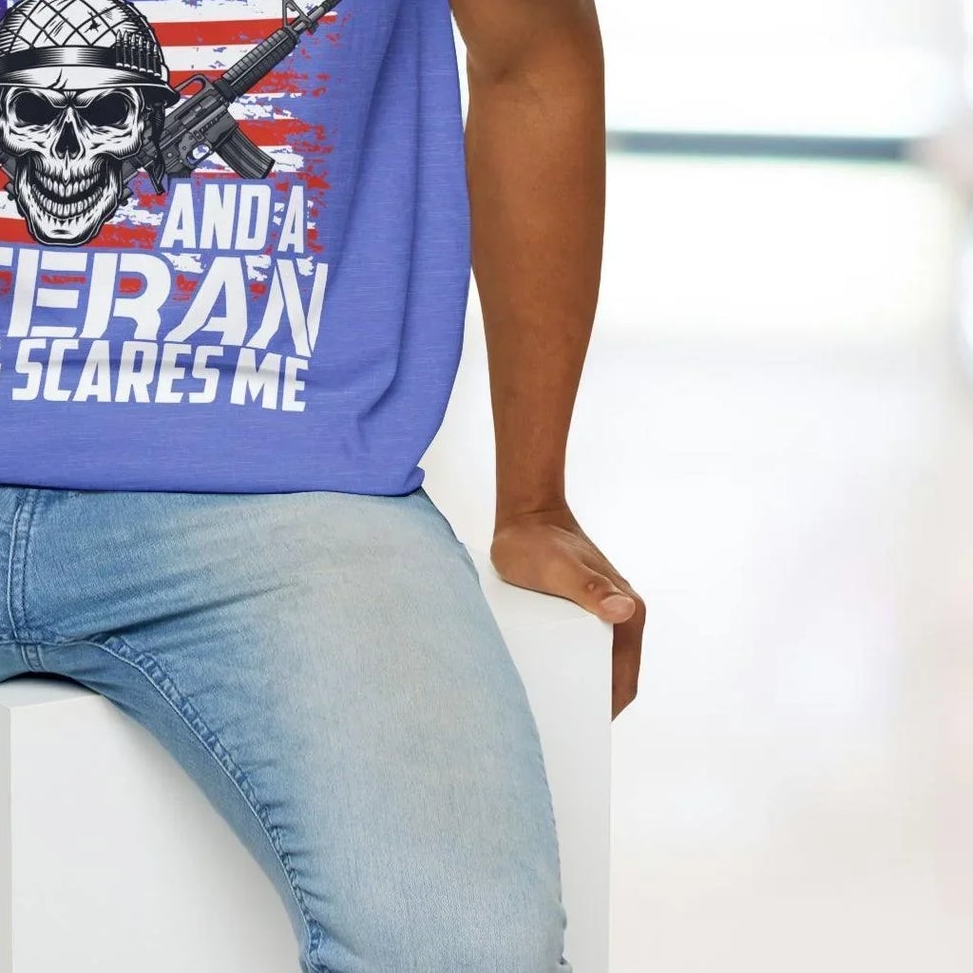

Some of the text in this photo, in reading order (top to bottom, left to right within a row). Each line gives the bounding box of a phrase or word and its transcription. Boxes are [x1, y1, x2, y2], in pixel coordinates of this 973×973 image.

[160, 183, 305, 254] AND A
[11, 338, 224, 404] SCARES
[230, 347, 309, 412] ME
